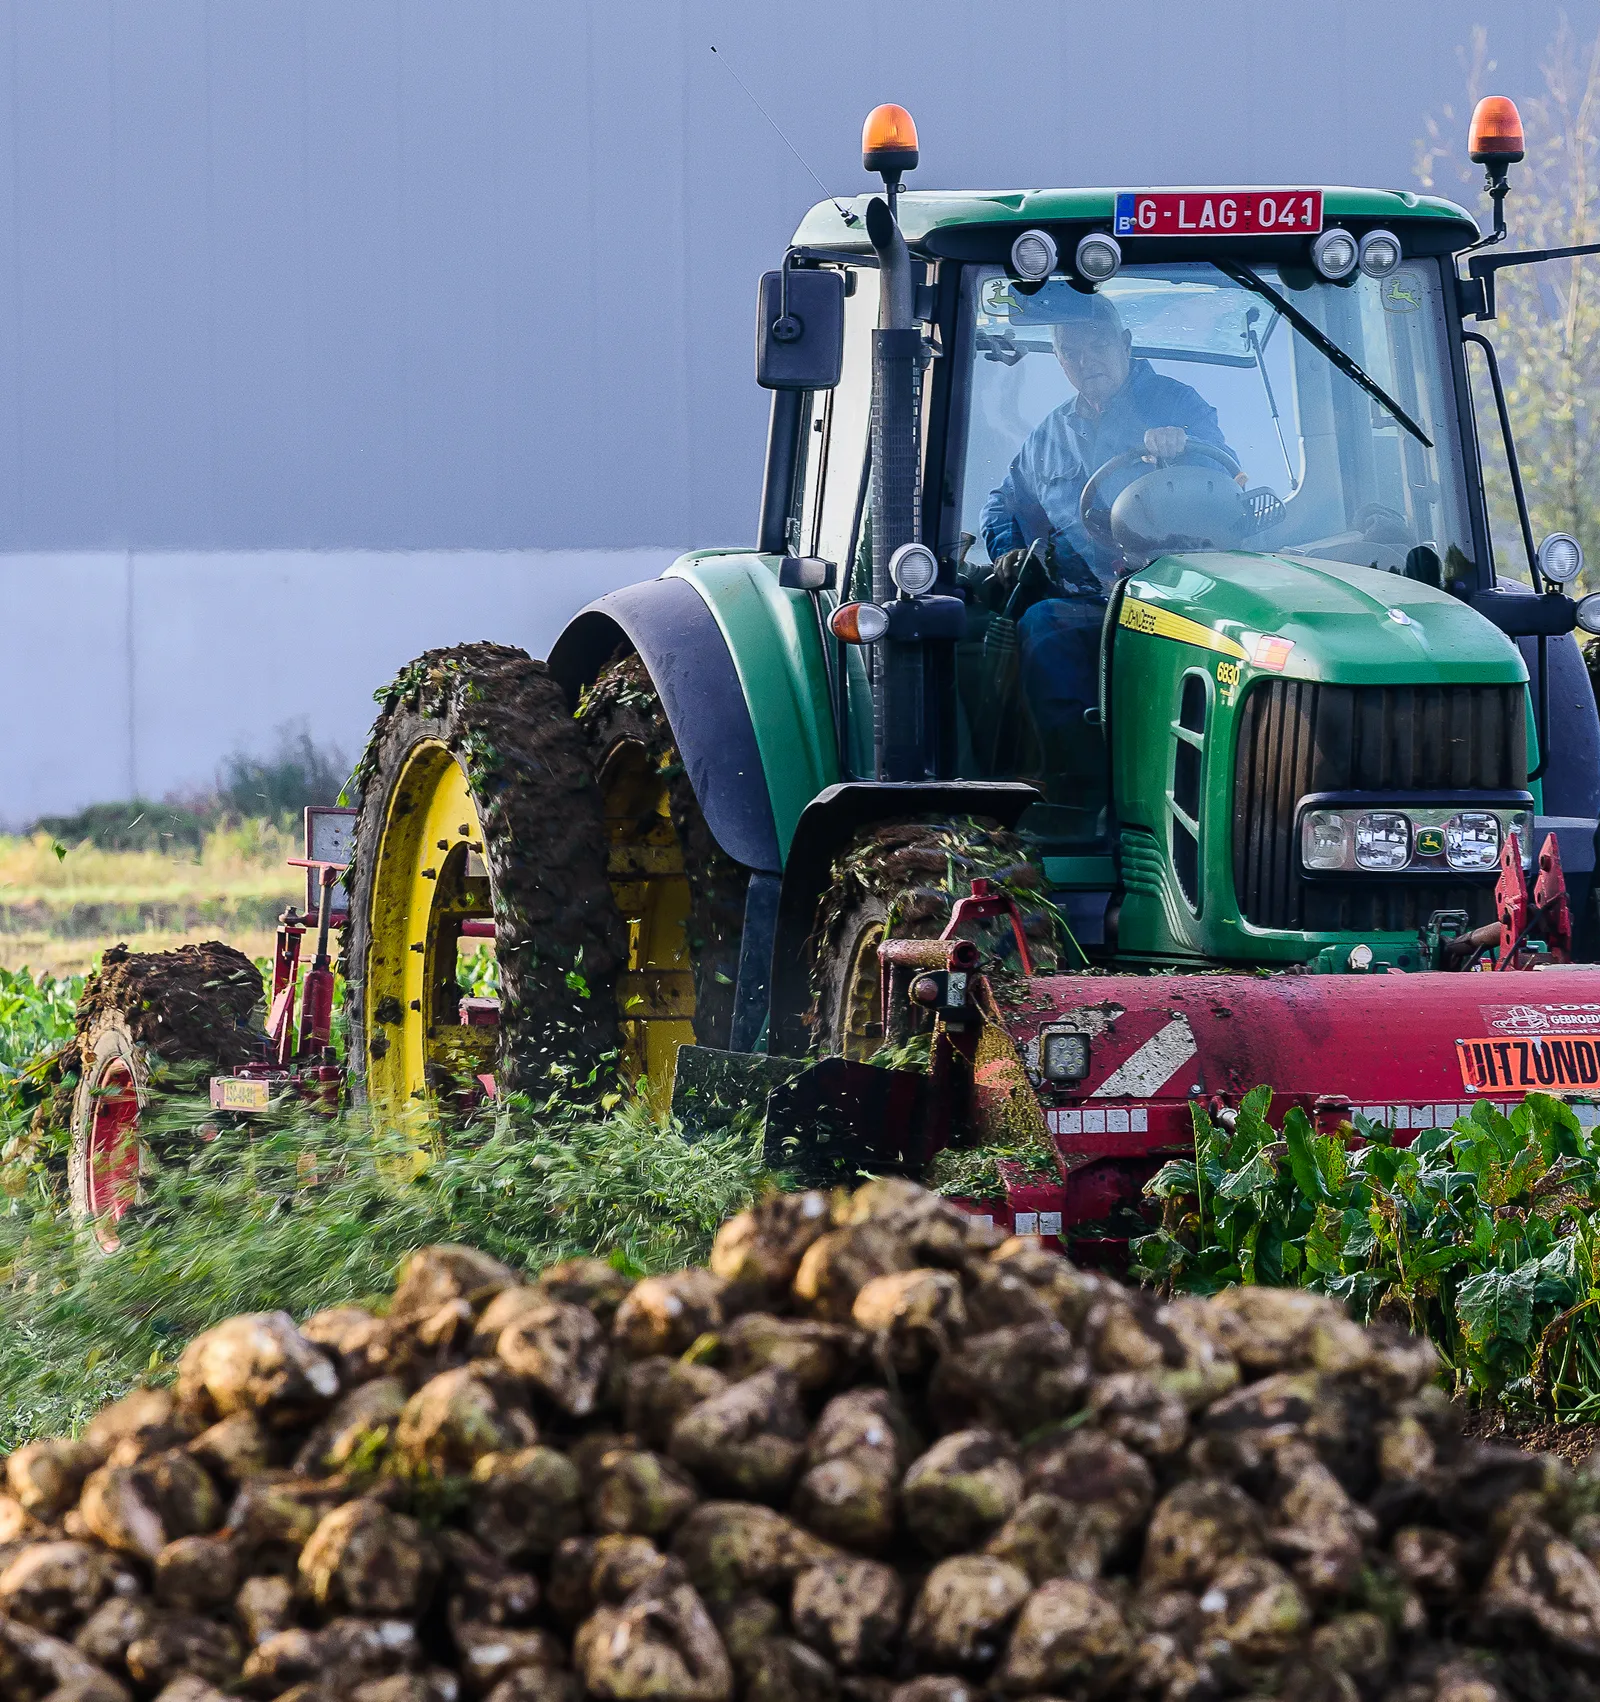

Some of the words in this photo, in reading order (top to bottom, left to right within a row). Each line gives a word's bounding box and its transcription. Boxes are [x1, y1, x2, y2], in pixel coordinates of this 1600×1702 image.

[1119, 216, 1131, 230] B
[1138, 197, 1314, 229] G-LAG-041
[1217, 661, 1240, 686] 6830
